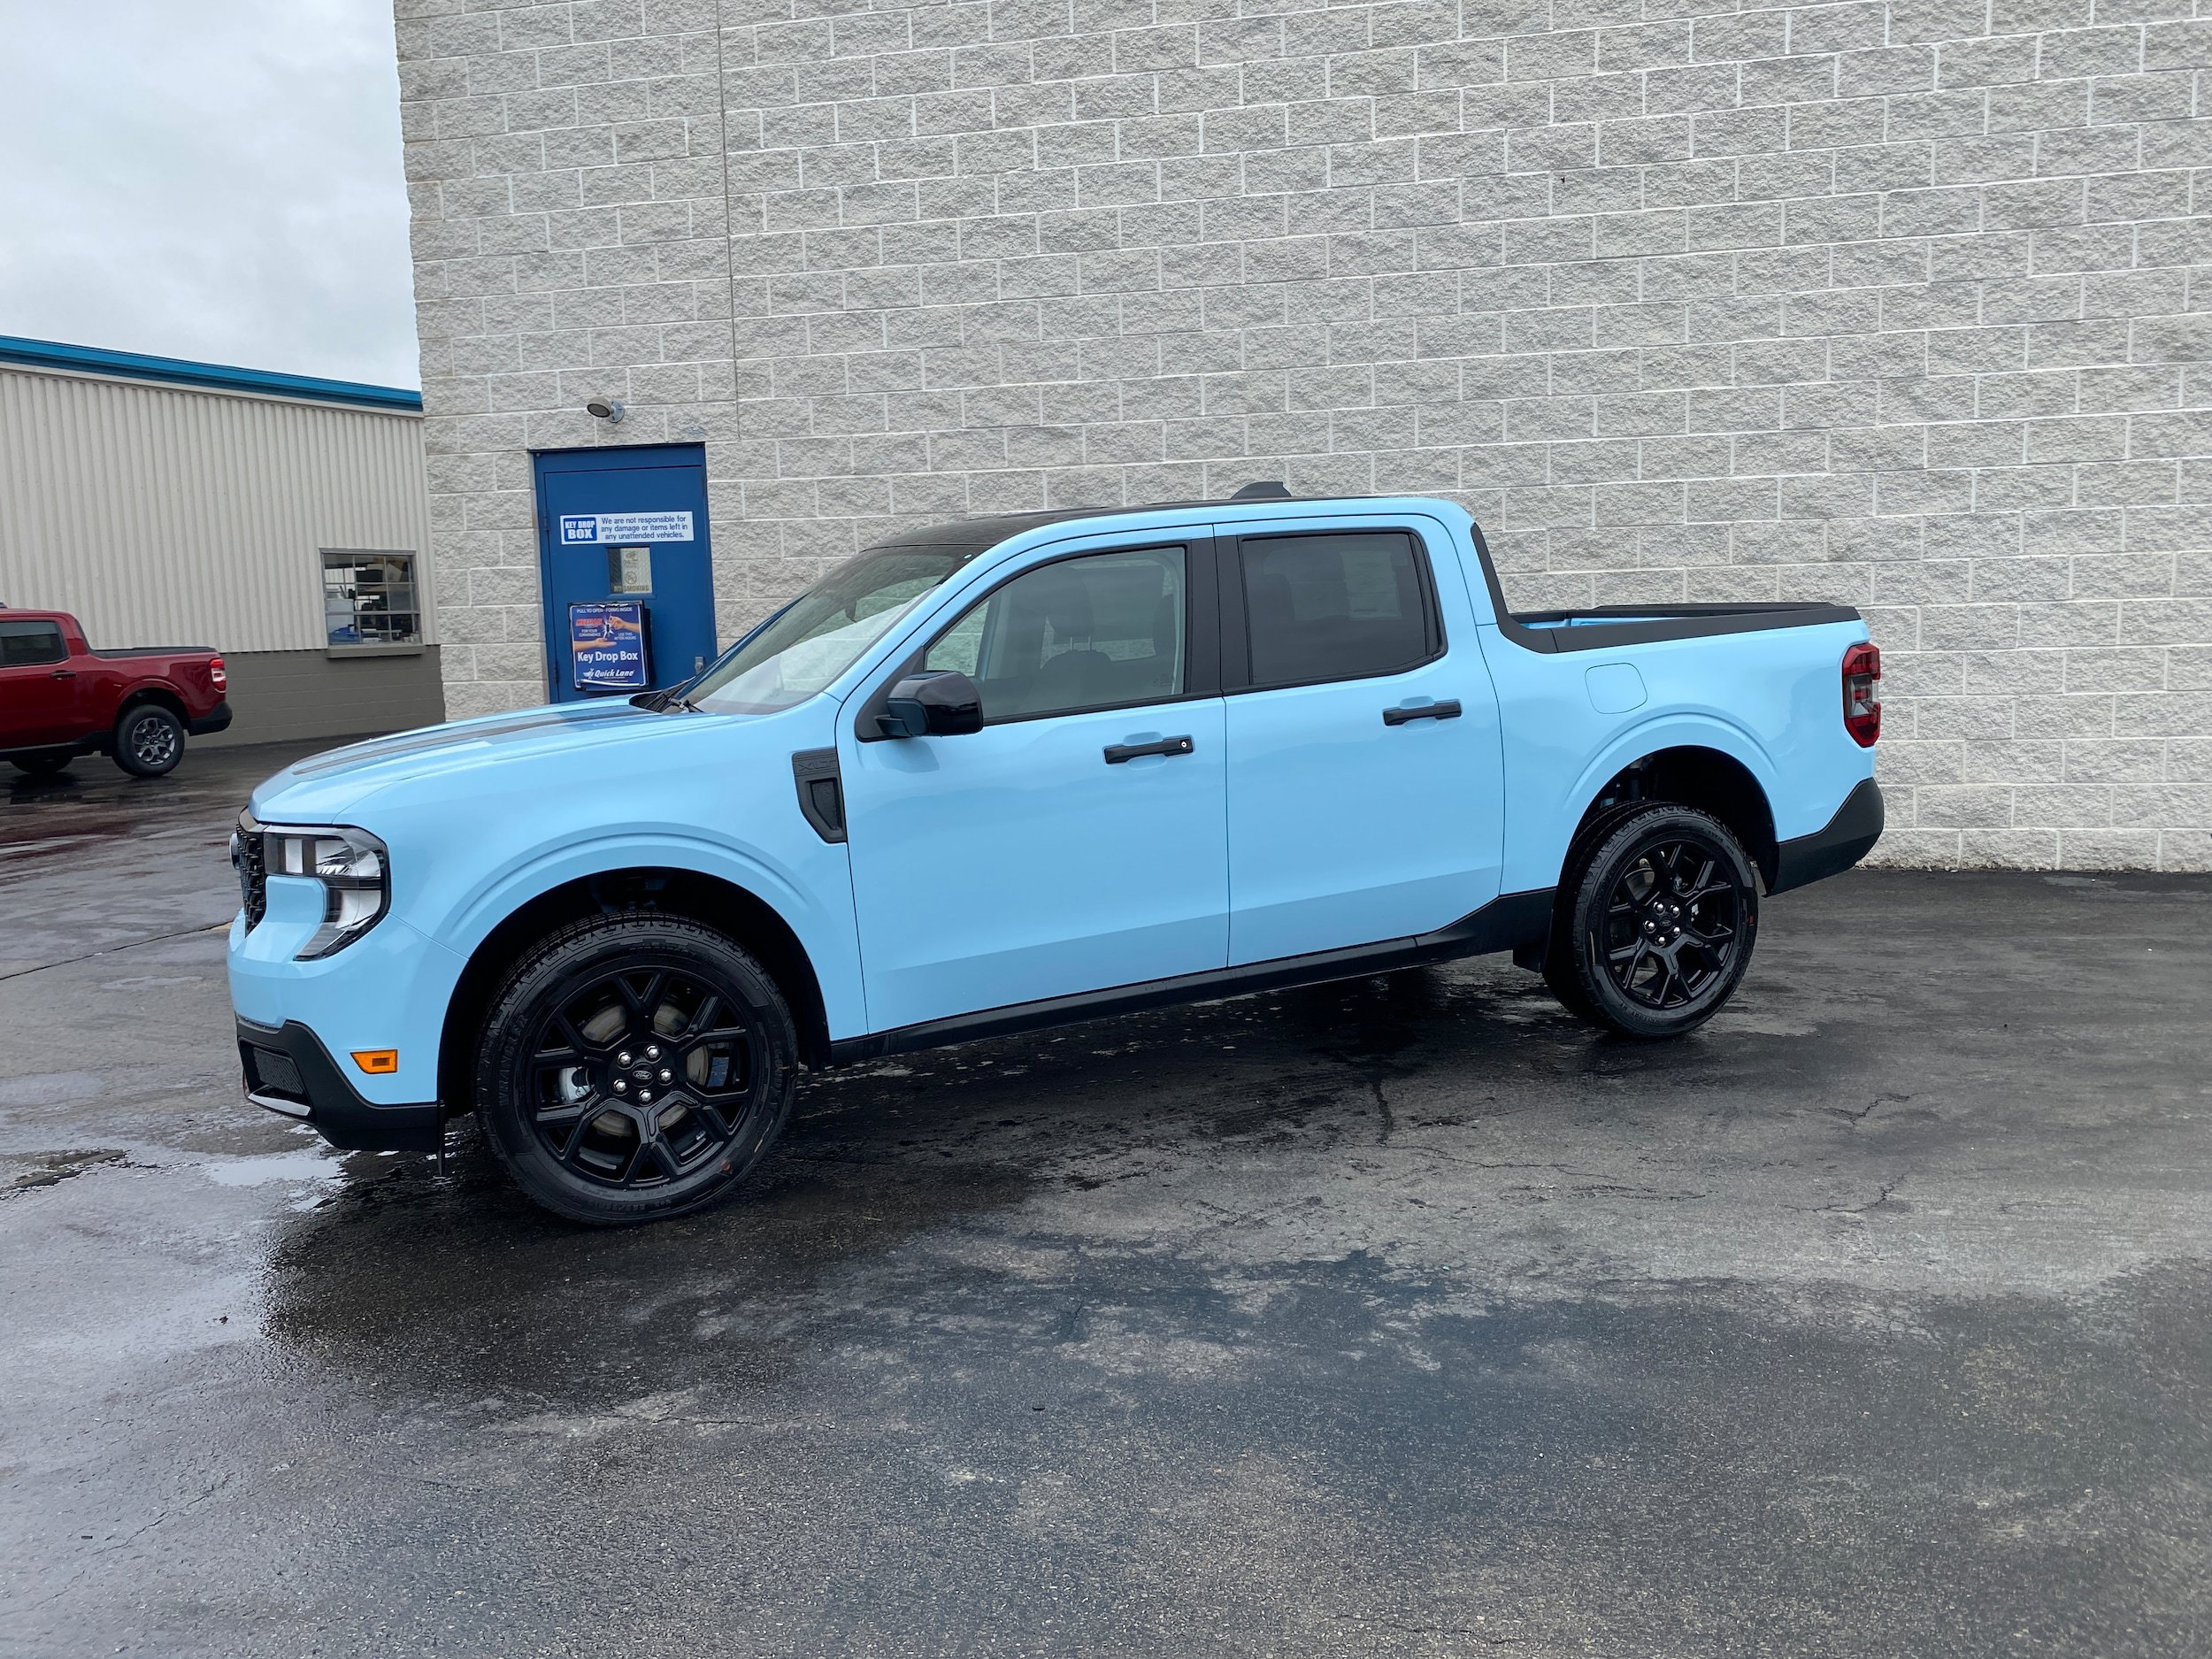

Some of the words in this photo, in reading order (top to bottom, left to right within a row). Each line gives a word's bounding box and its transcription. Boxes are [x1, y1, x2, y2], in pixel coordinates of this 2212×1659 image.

[565, 520, 577, 529] KEY
[638, 516, 675, 525] responsible
[567, 528, 593, 539] BOX
[577, 652, 594, 664] Key
[595, 651, 618, 663] Drop
[620, 650, 638, 661] Box
[595, 669, 615, 678] Quick
[798, 760, 836, 772] XLT
